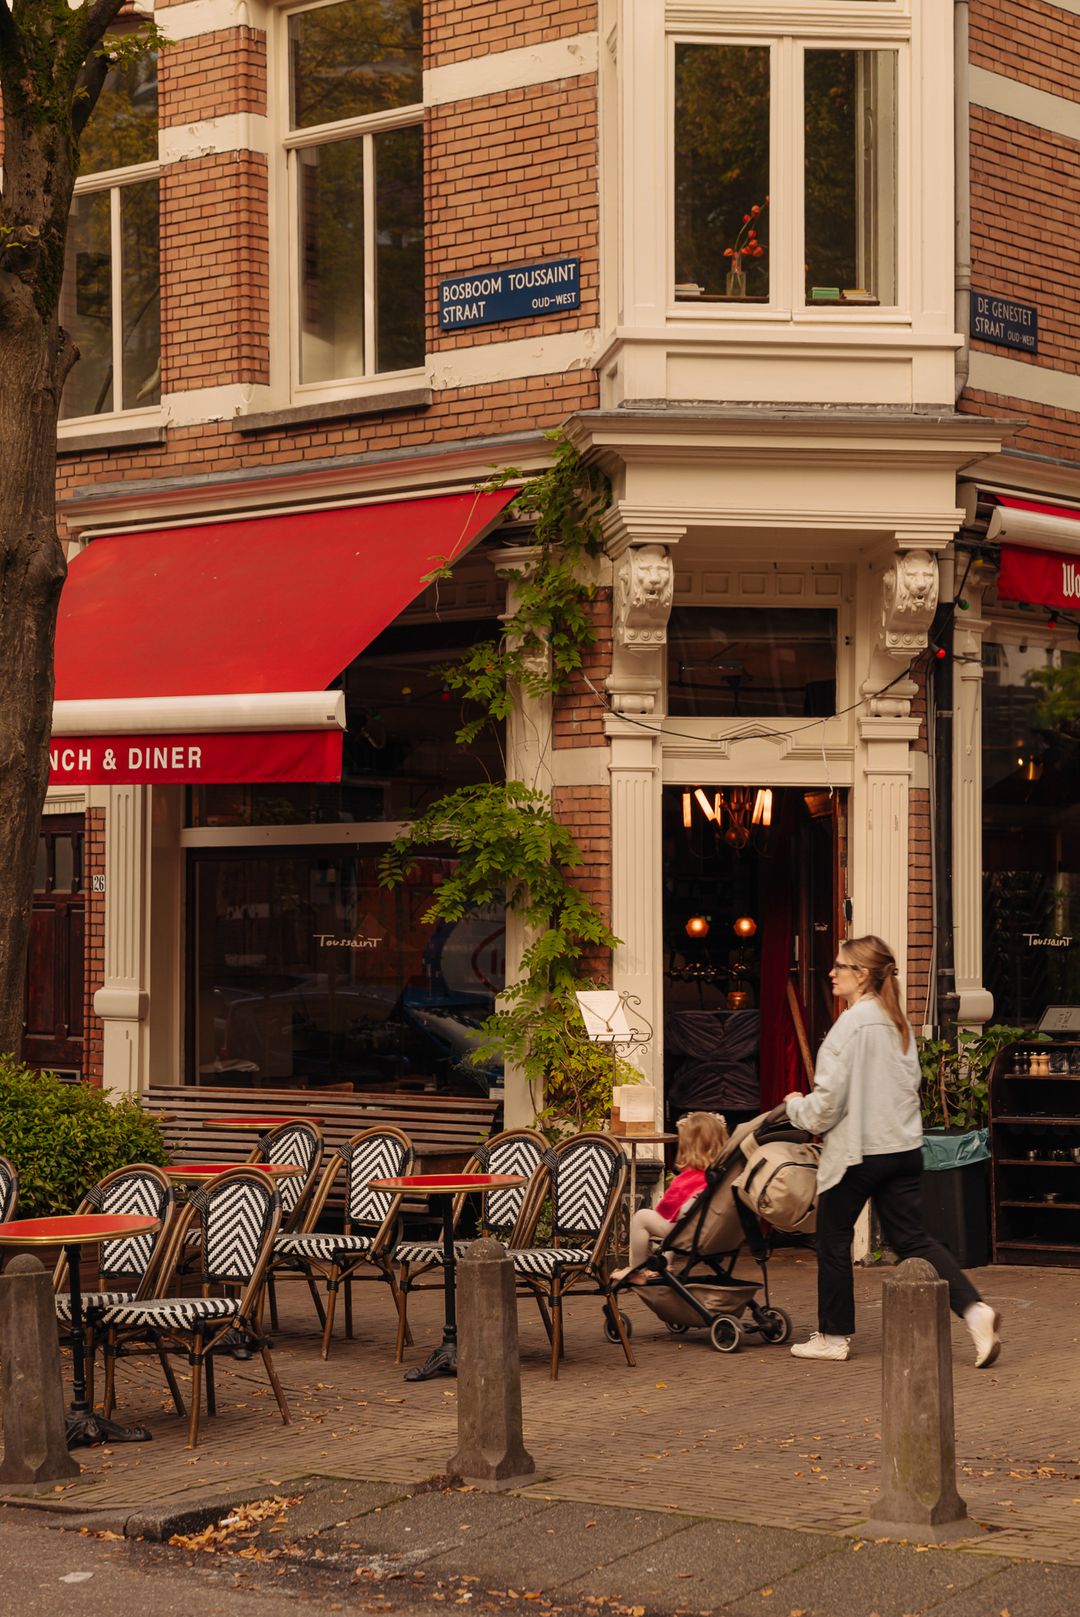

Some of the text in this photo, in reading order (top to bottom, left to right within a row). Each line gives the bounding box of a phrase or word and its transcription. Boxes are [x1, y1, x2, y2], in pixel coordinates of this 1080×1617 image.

[442, 263, 576, 303] BOSBOOM TOUSSAINT
[531, 292, 577, 309] OUD-WEST
[977, 296, 1032, 327] DE GENESTET
[442, 301, 486, 324] STRAAT
[975, 316, 1005, 338] STRAAT
[1007, 331, 1035, 347] OUD-WEST
[102, 748, 117, 770] &
[128, 746, 202, 770] DINER
[94, 875, 104, 891] 26
